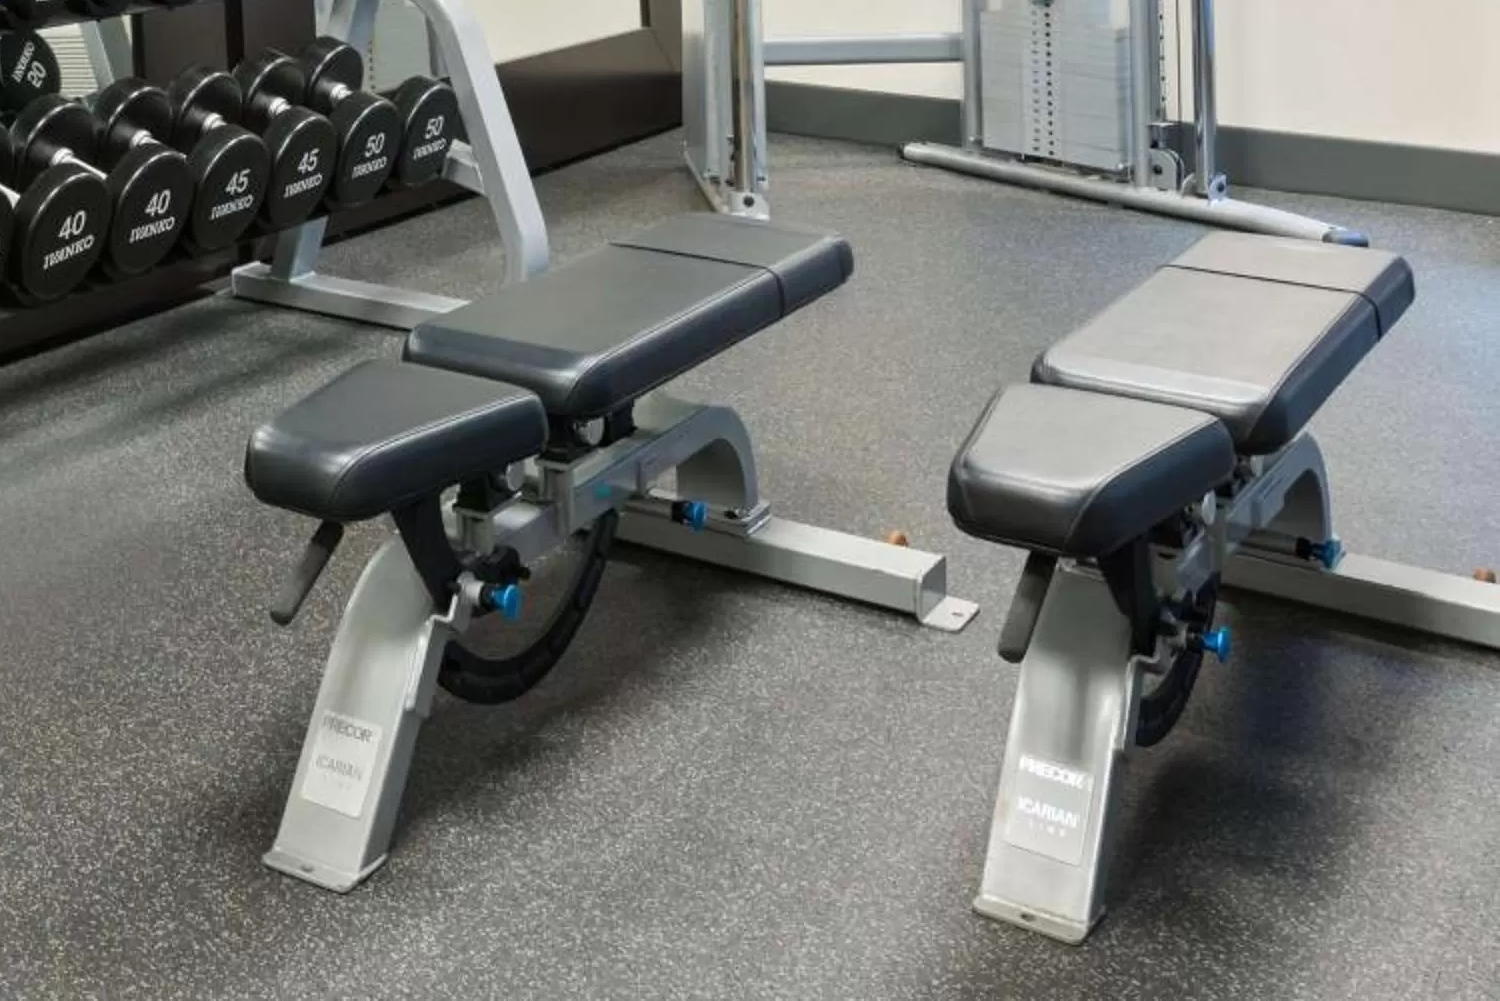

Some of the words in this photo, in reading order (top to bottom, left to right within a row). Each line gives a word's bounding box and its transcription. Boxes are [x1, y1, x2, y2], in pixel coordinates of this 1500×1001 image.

[424, 115, 445, 139] 50
[364, 132, 385, 158] 50
[297, 148, 320, 174] 45
[225, 168, 251, 196] 45
[144, 189, 171, 216] 40
[58, 210, 87, 239] 40
[43, 234, 95, 270] IVANKO
